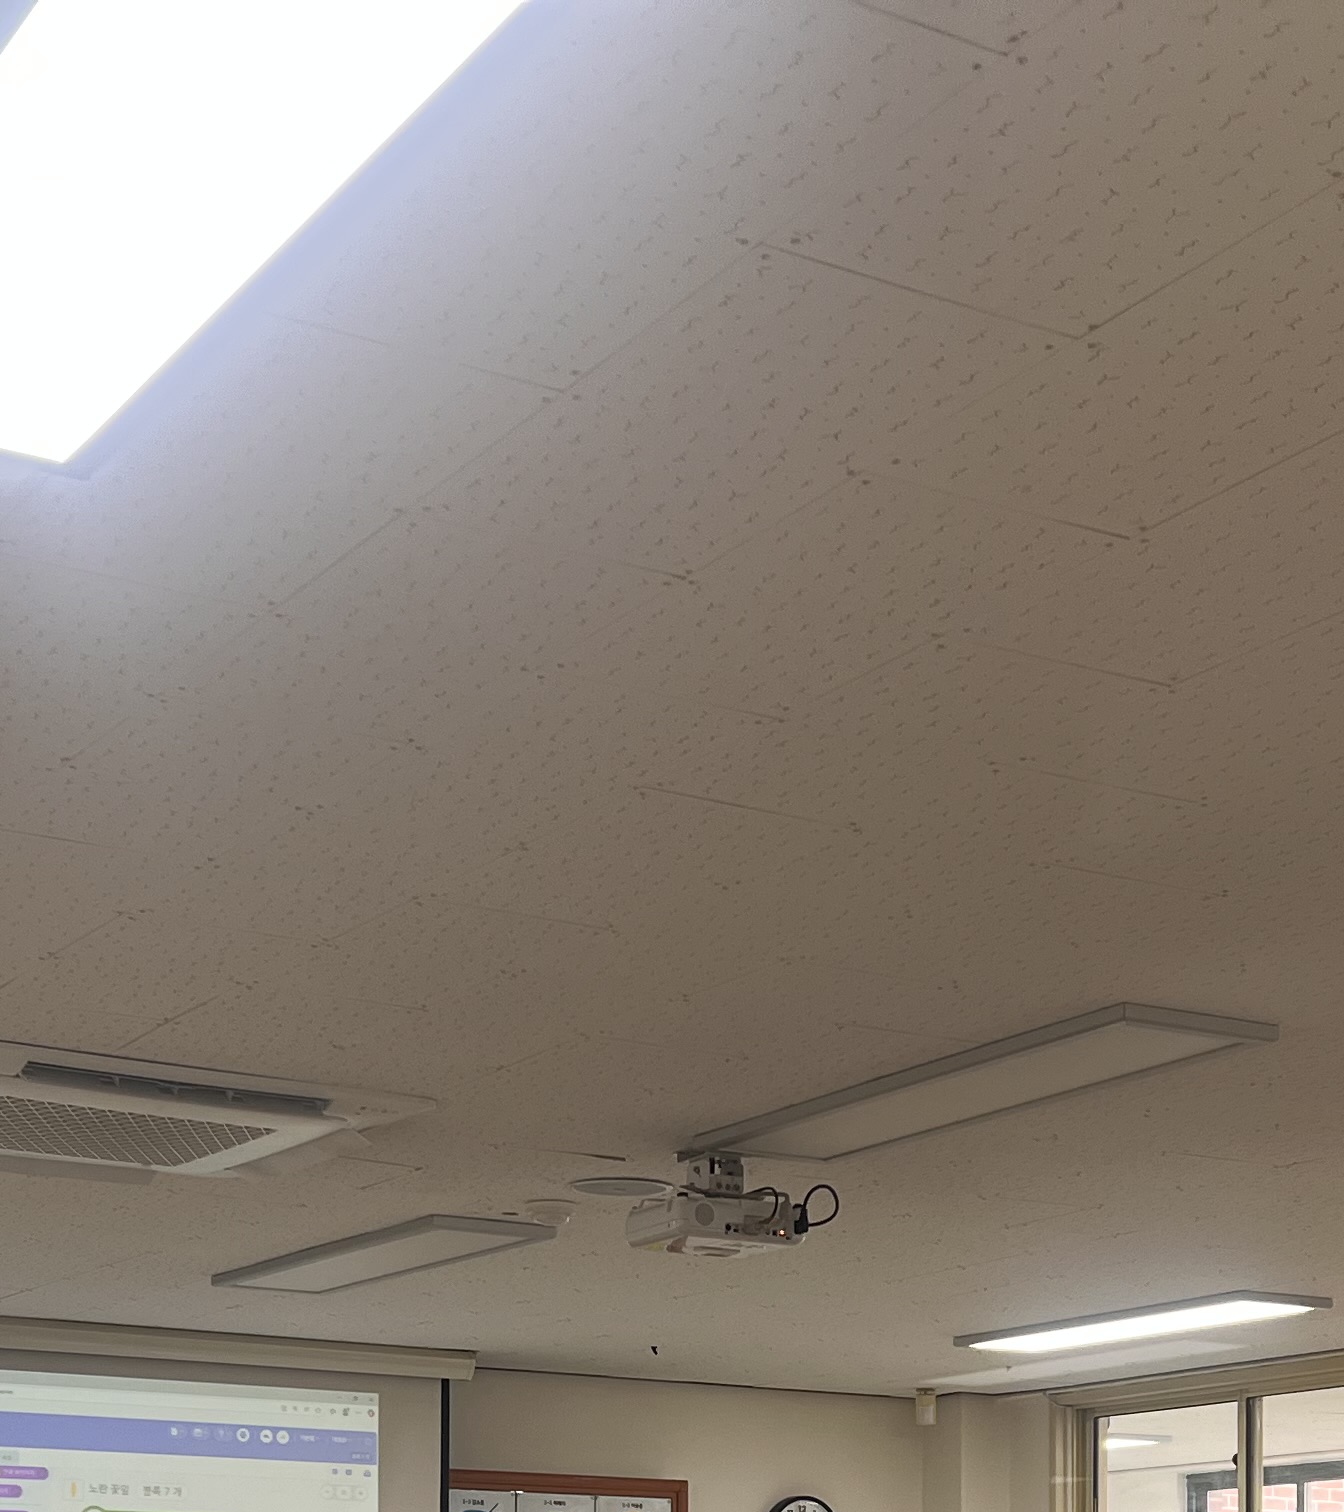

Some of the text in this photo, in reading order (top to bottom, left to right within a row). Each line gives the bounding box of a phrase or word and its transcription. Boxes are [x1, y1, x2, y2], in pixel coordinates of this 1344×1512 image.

[88, 1483, 129, 1496] 노란 꽃잎
[172, 1486, 183, 1497] 개
[798, 1505, 807, 1512] 12
